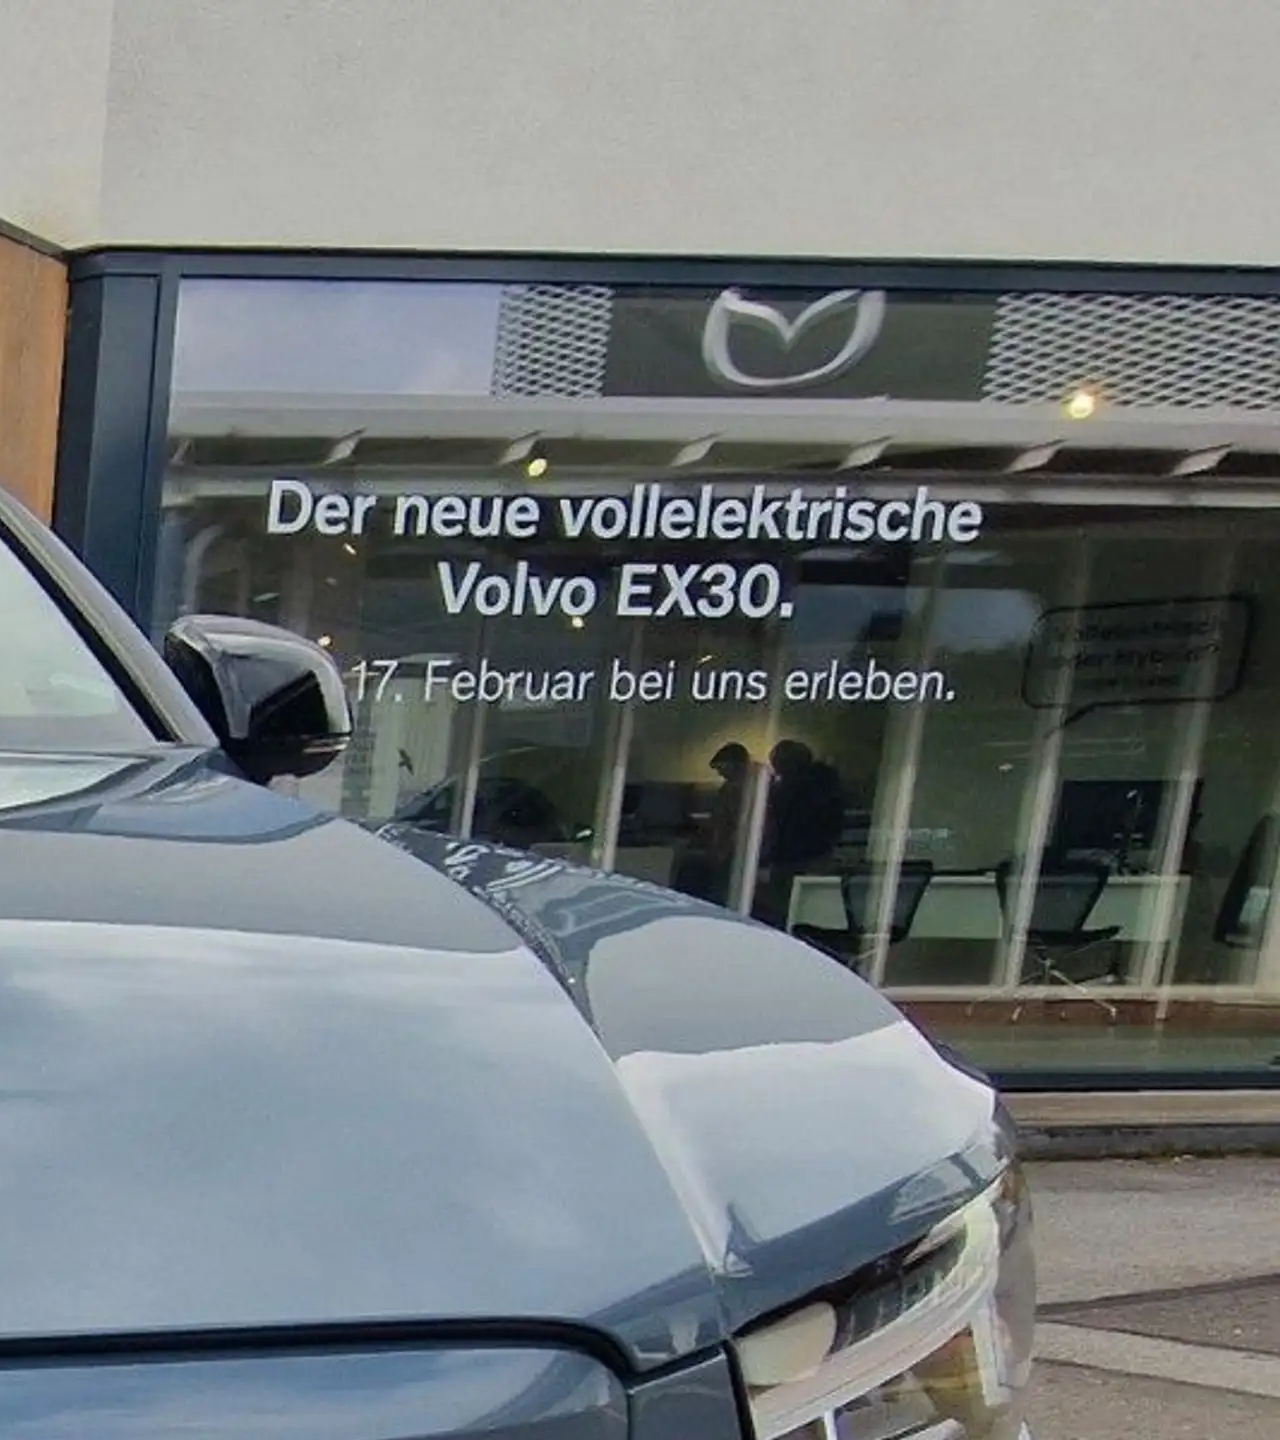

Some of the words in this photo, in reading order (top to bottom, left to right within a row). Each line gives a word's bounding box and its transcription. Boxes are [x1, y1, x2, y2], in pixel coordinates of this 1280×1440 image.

[266, 479, 378, 536] Der
[393, 494, 541, 538] neue
[558, 482, 983, 541] vollelektrische
[437, 561, 597, 616] Volvo
[616, 562, 794, 618] EX30.
[351, 659, 403, 701] 17.
[424, 657, 595, 702] Februar
[610, 657, 675, 702] bei
[691, 670, 767, 701] uns
[784, 661, 956, 701] erleben.
